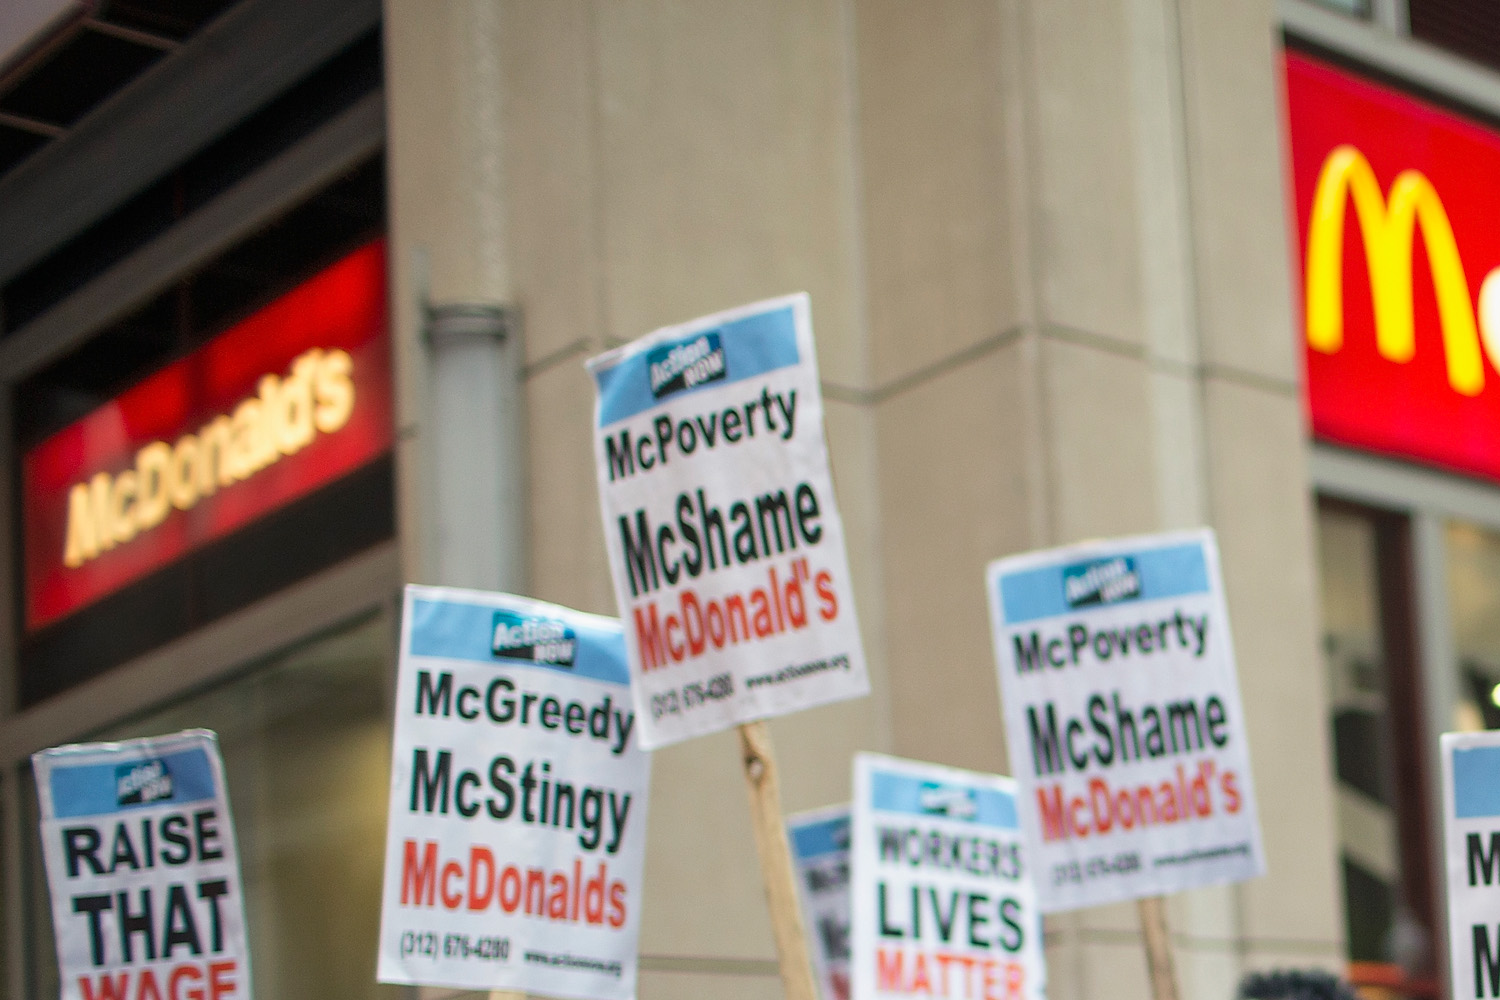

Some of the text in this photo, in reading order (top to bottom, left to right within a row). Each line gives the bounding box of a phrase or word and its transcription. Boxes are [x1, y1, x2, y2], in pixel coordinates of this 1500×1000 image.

[64, 347, 356, 568] McDonald's
[605, 386, 797, 482] McPoverty
[619, 482, 823, 597] McShame
[634, 557, 840, 674] McDonald's
[1013, 608, 1208, 675] McPoverty
[416, 670, 634, 755] McGreedy
[1026, 691, 1229, 777] McShame
[62, 810, 223, 878] RAISE
[409, 749, 631, 854] McStingy
[1037, 758, 1243, 844] McDonald's
[400, 839, 628, 929] McDonalds
[877, 824, 1022, 881] WORKERS
[73, 880, 228, 966] THAT
[876, 881, 1024, 953] LIVES
